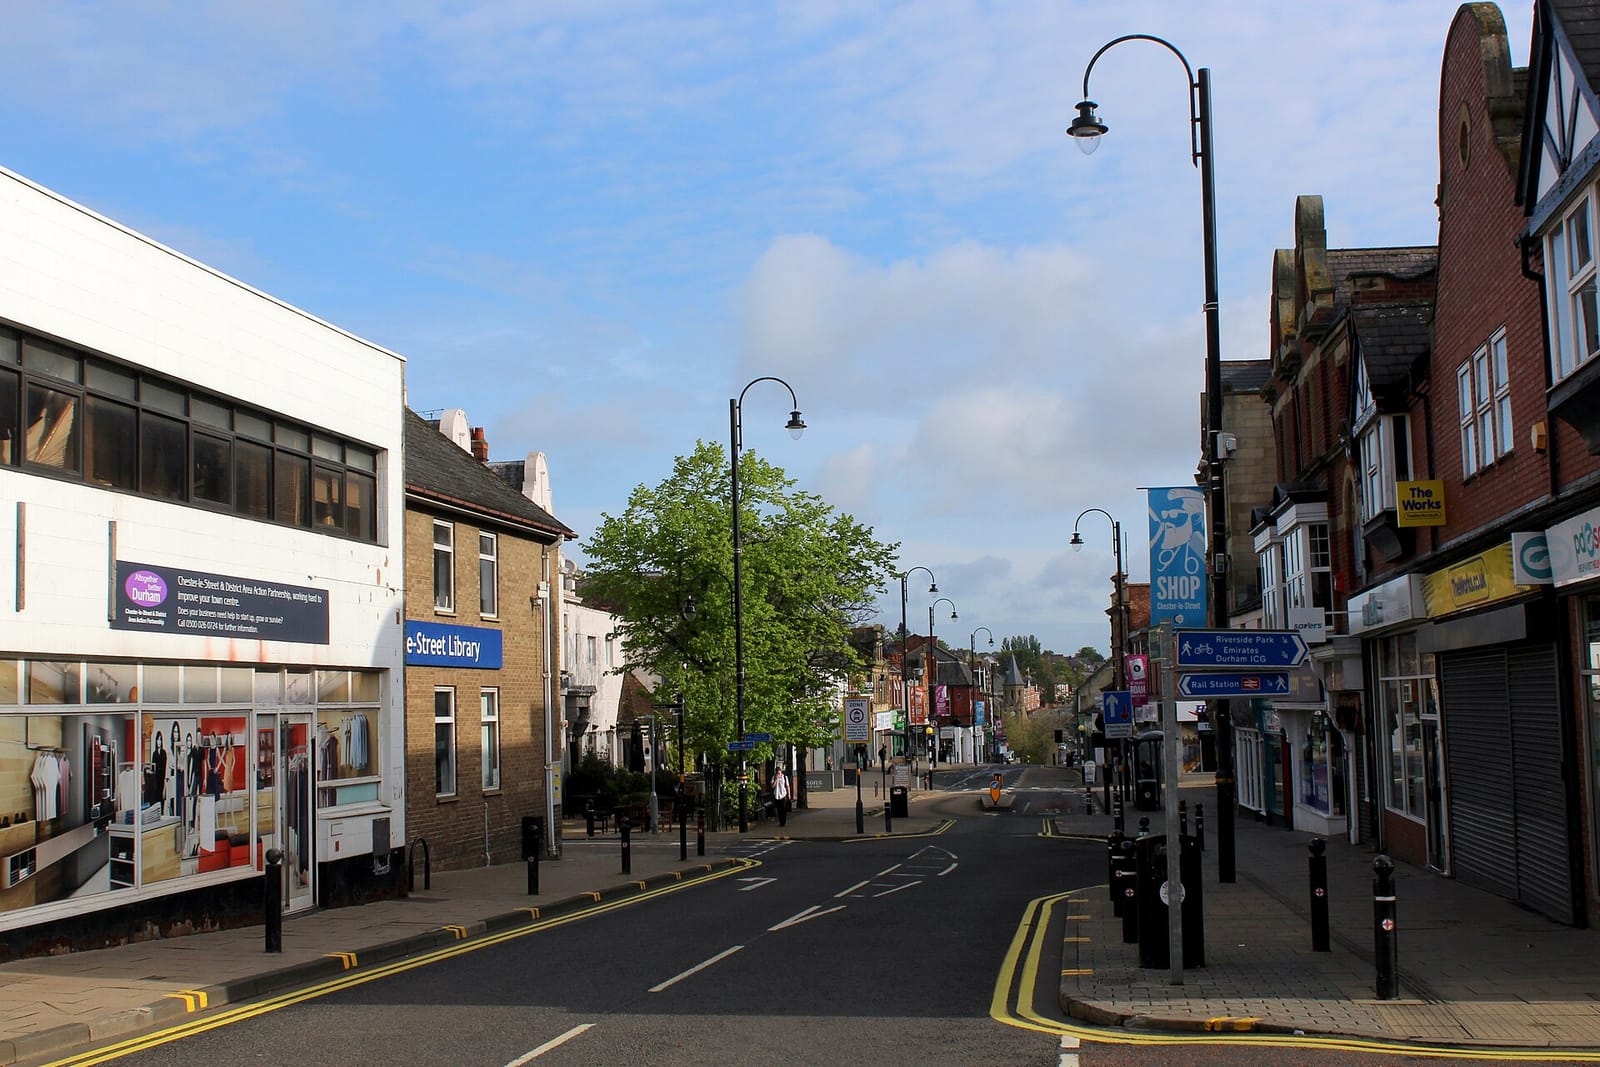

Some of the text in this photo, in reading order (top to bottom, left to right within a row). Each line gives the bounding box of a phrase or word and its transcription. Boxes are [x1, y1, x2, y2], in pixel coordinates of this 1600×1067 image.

[1409, 487, 1432, 498] The
[1402, 499, 1441, 511] Works
[178, 575, 219, 591] Chester-le-Street
[219, 581, 225, 591] &
[225, 582, 242, 593] District
[242, 584, 253, 594] Area
[253, 586, 267, 596] Action
[317, 593, 323, 603] to
[1157, 575, 1201, 600] SHOP
[132, 587, 161, 603] Durham
[199, 594, 210, 605] your
[211, 595, 223, 605] town
[1157, 601, 1201, 610] Chester-le-Street
[177, 606, 189, 615] Does
[189, 609, 198, 617] your
[198, 609, 217, 618] business
[177, 618, 185, 627] Call
[1216, 635, 1253, 644] Riverside
[1255, 635, 1274, 644] Park
[448, 634, 480, 663] Library
[1223, 646, 1259, 654] Emirates
[1215, 655, 1247, 663] Durham
[1250, 655, 1267, 663] ICG
[1191, 681, 1207, 689] Rail
[1209, 680, 1240, 688] Station
